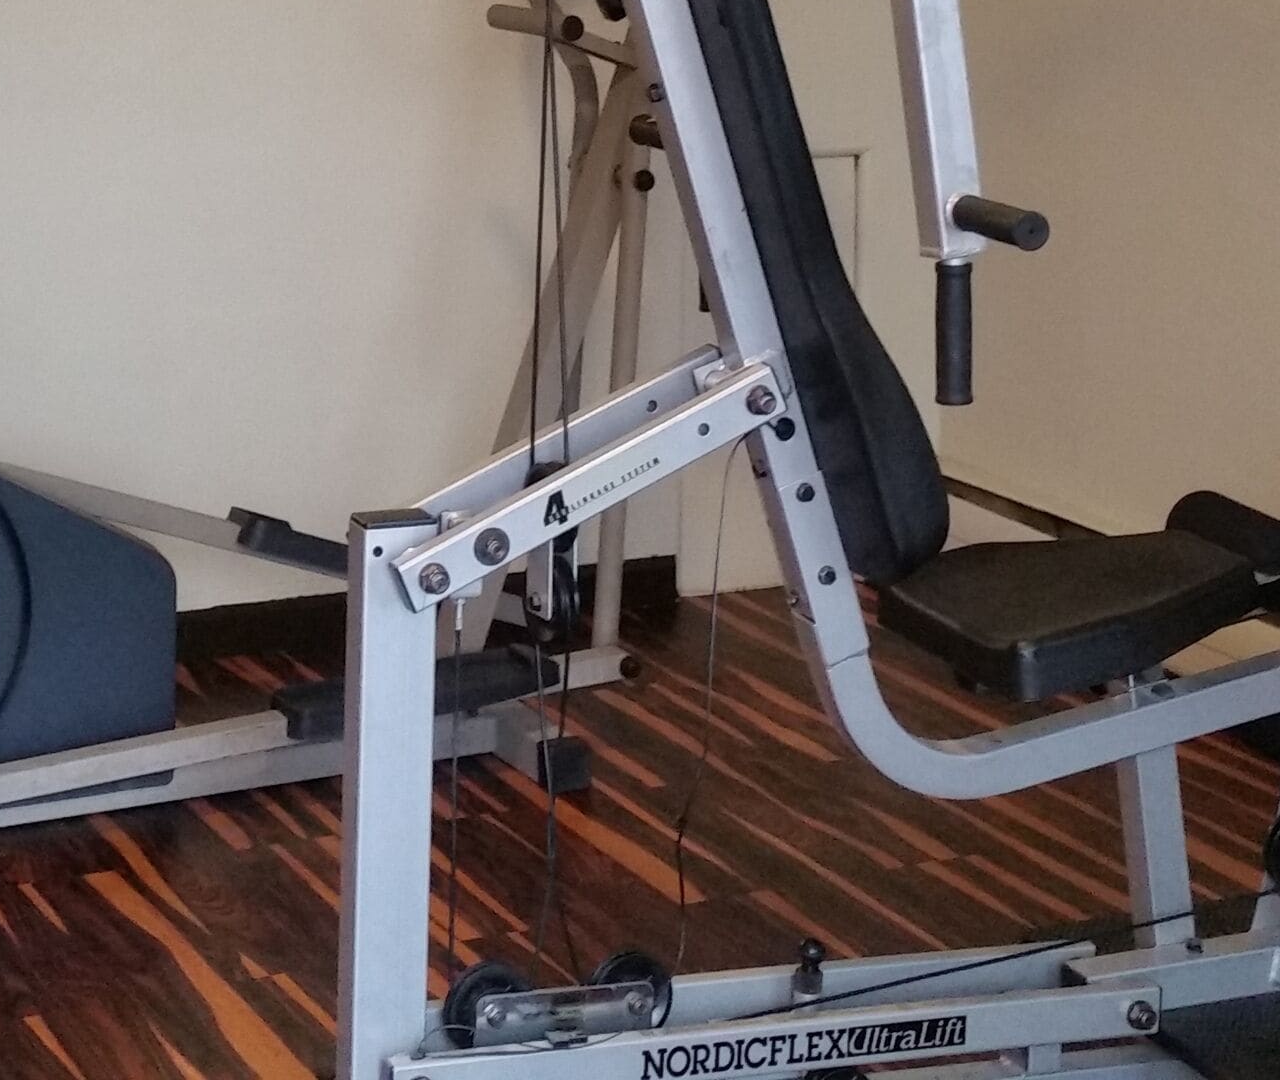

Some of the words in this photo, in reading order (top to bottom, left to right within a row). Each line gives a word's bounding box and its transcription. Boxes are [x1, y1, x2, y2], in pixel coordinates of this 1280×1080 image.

[544, 489, 569, 527] 4
[571, 481, 616, 511] LINKAGE
[620, 457, 661, 484] SYSTEM
[641, 1029, 847, 1080] NORDICFLEX
[849, 1018, 964, 1055] UltraLift
